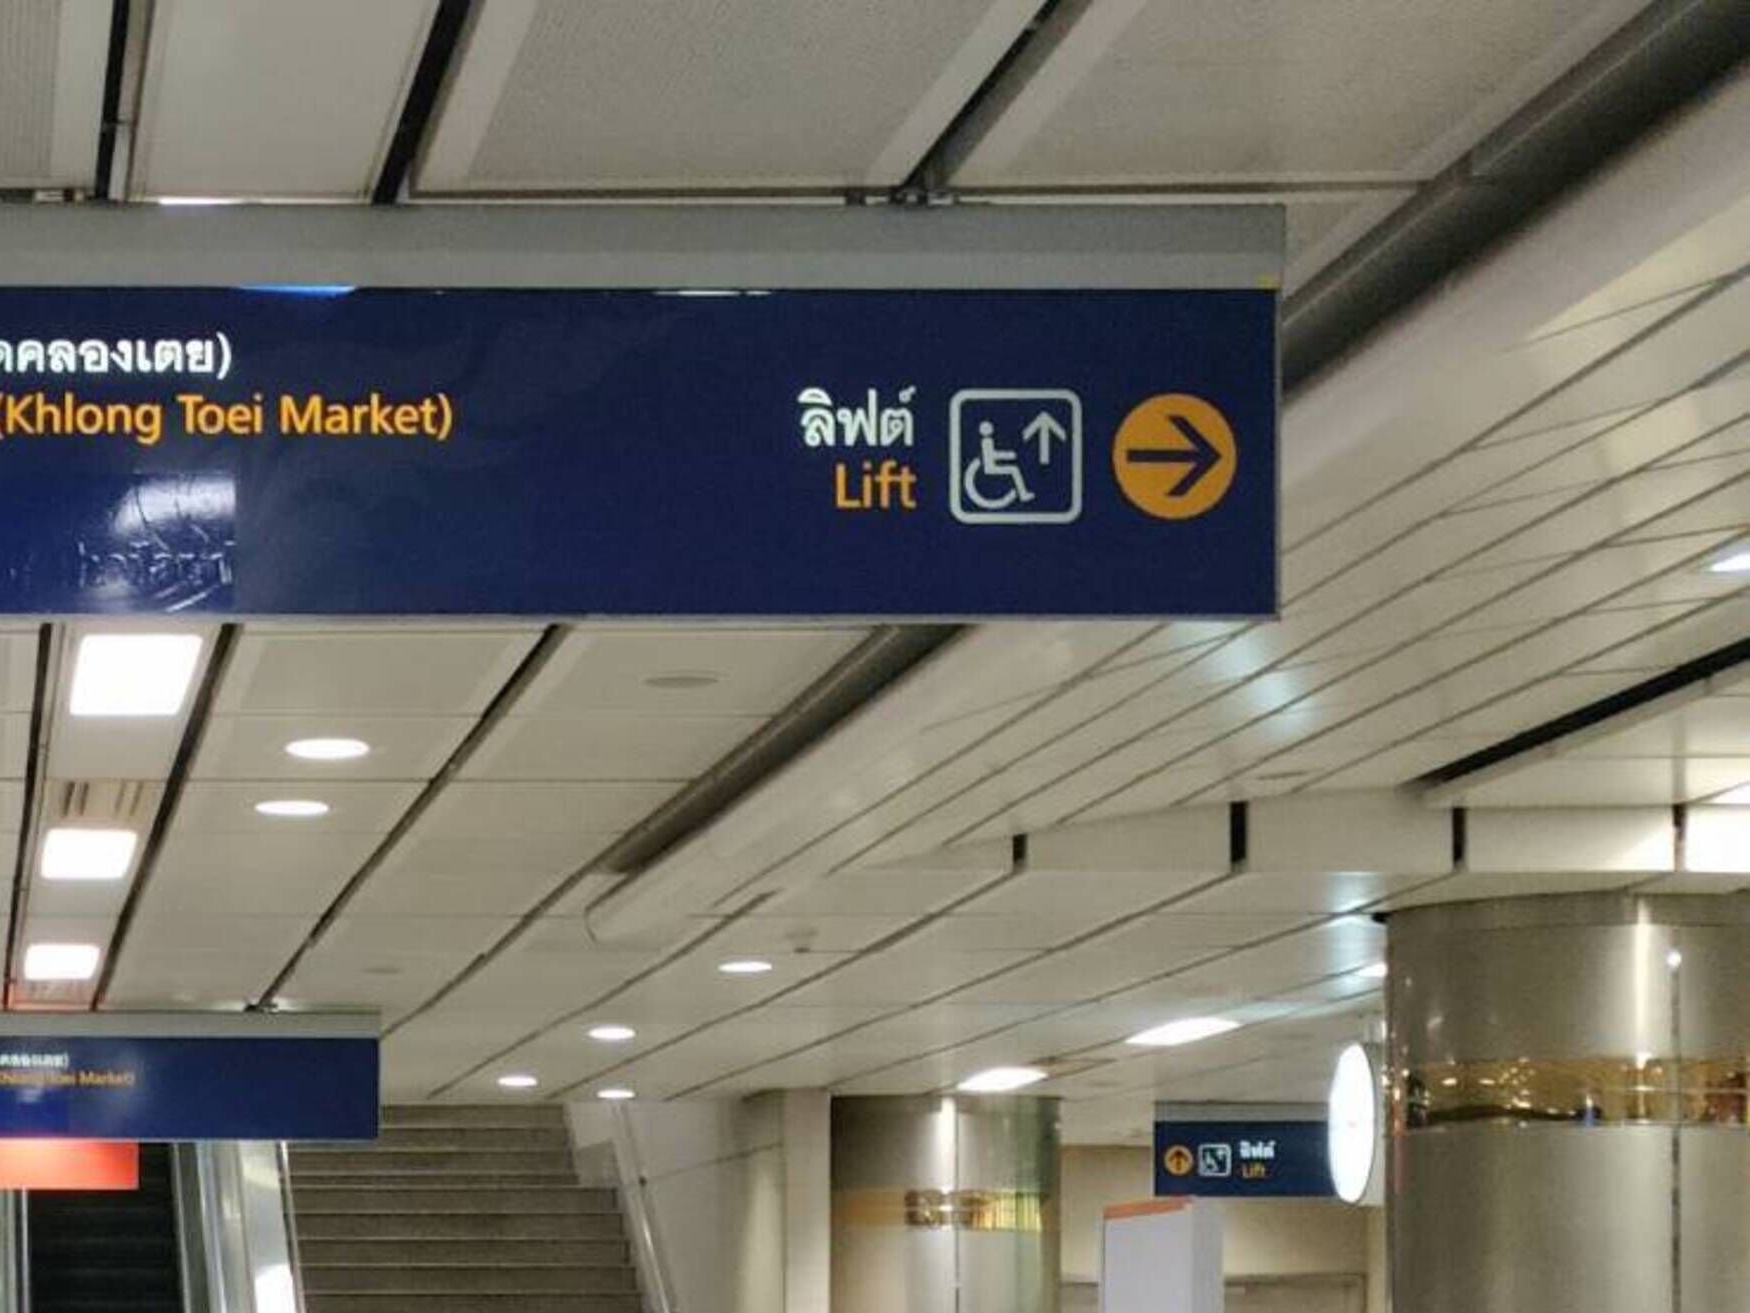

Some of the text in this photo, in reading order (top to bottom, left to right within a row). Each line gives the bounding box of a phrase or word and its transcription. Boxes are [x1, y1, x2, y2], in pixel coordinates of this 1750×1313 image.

[176, 394, 265, 435] Toei
[278, 393, 454, 441] Market)
[796, 385, 917, 448] ลิฟต์
[833, 458, 918, 510] Lift
